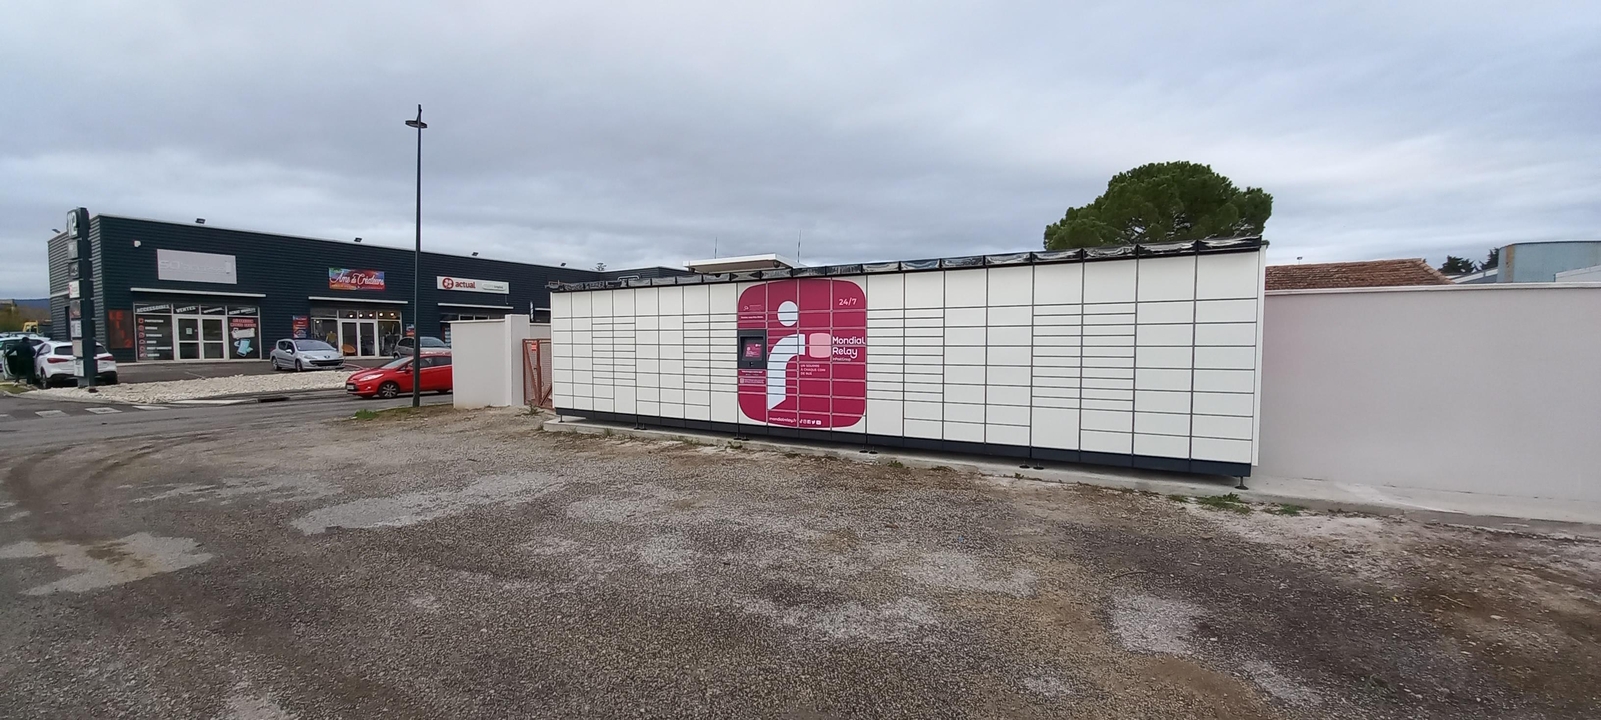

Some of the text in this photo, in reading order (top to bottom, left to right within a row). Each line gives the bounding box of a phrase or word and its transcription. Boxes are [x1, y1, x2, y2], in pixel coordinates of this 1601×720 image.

[455, 281, 476, 289] actual
[838, 298, 857, 306] 24/7
[832, 336, 866, 345] Mondial
[832, 346, 858, 359] Relay
